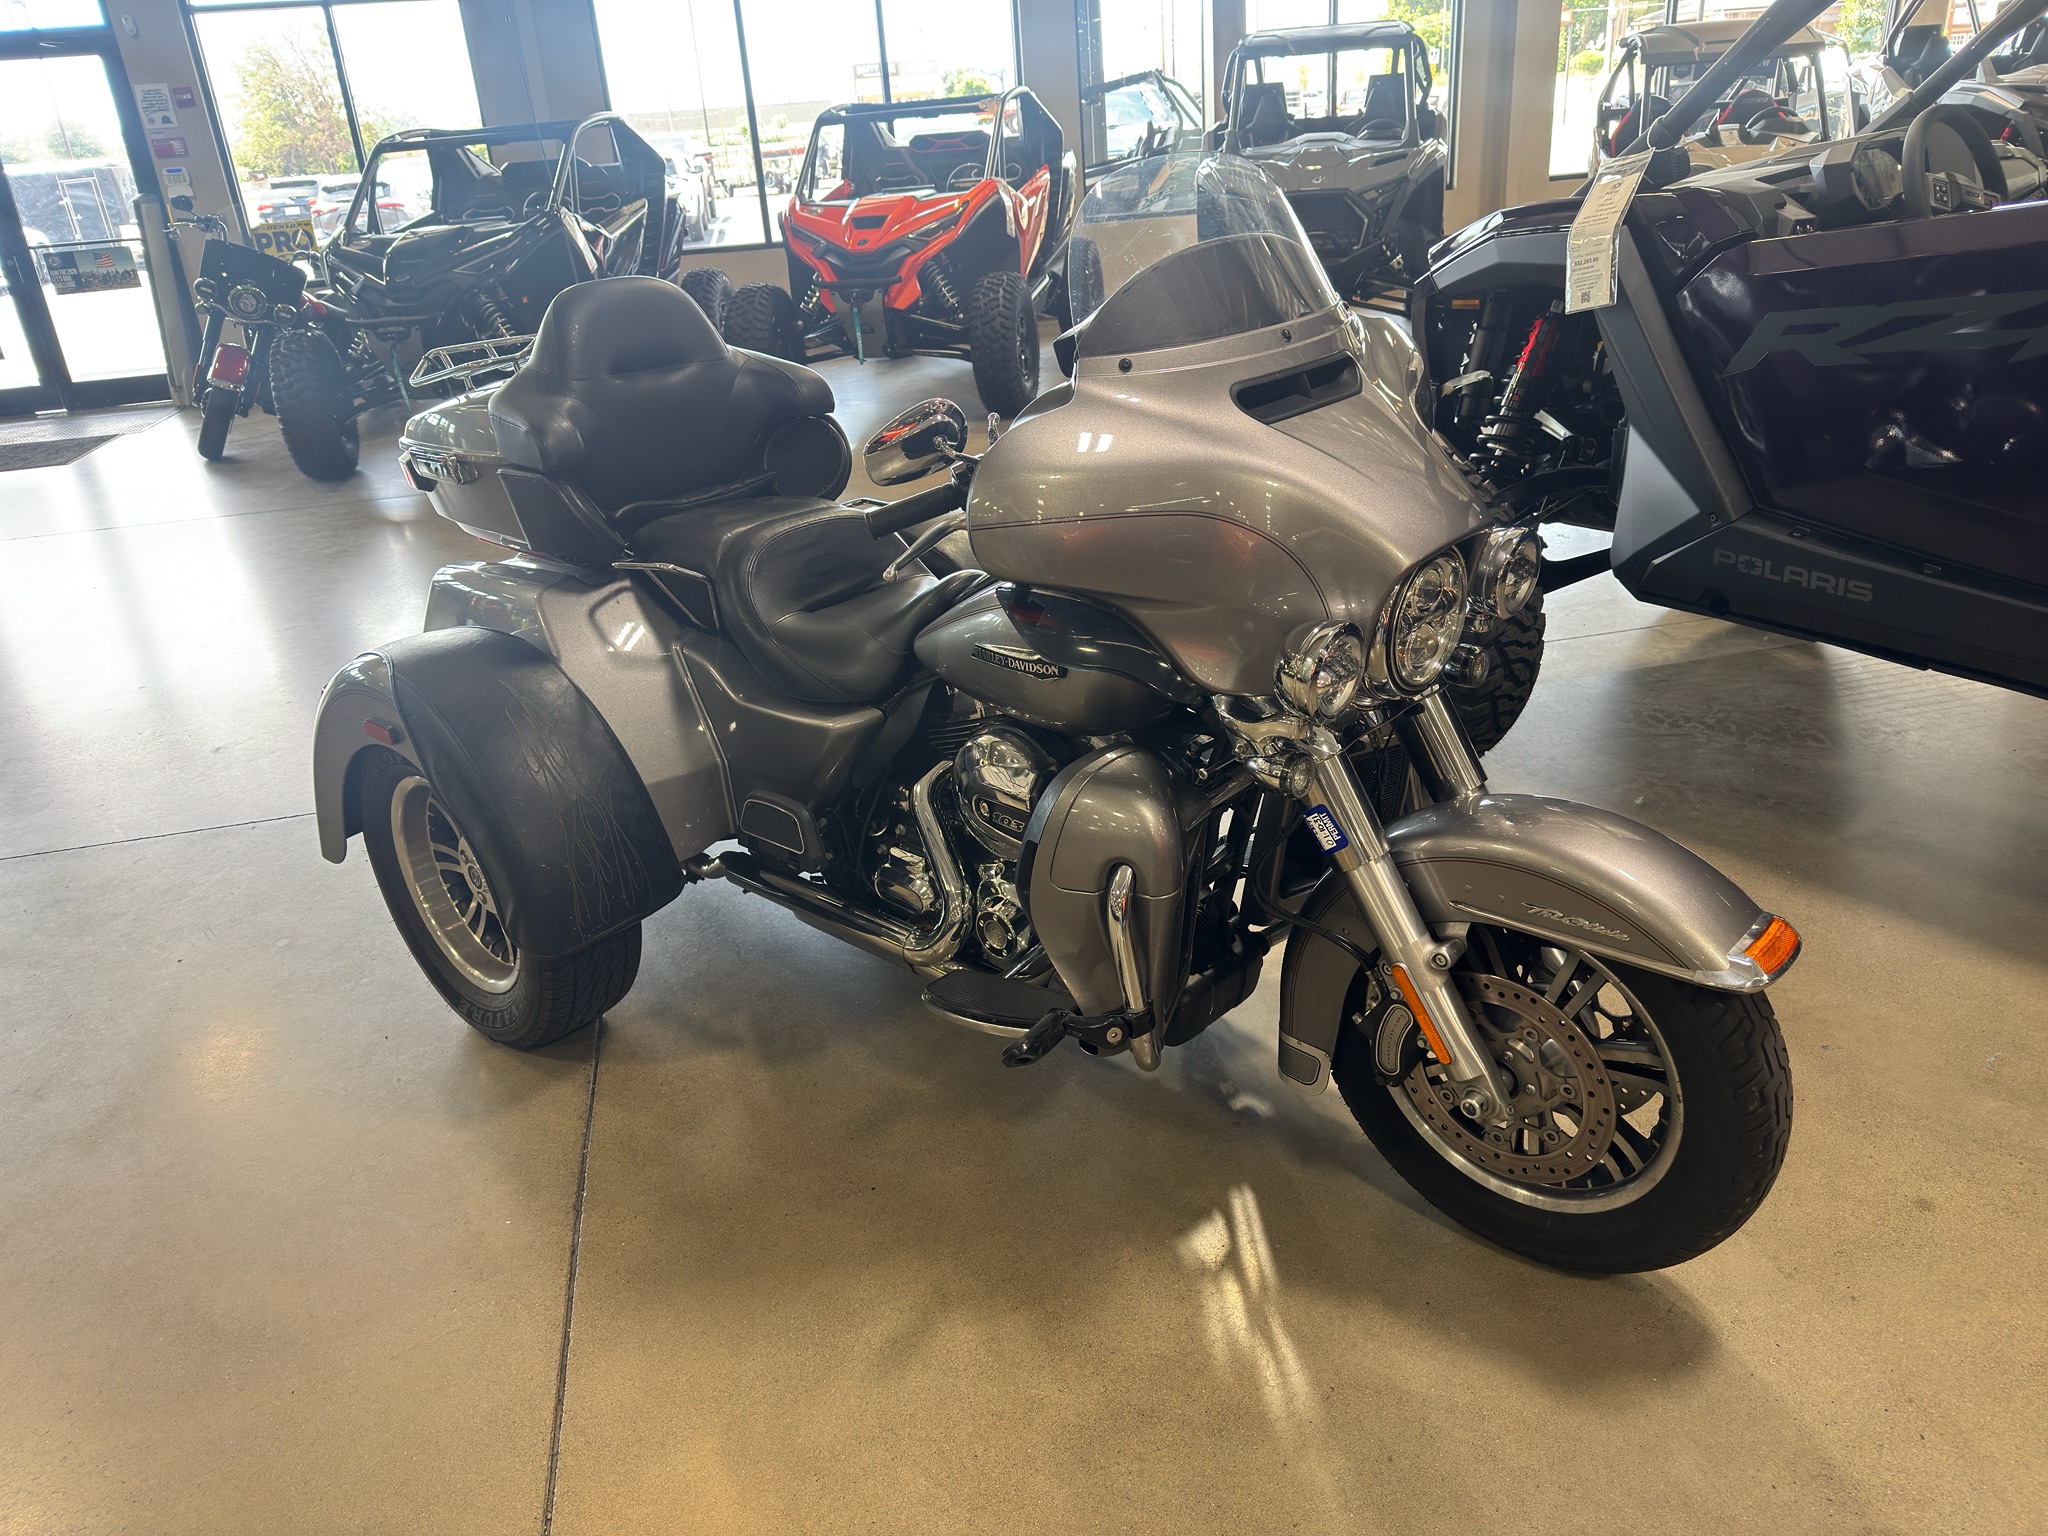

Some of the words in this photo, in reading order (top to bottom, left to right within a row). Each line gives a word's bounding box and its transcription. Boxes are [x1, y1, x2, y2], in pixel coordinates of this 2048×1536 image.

[255, 229, 314, 253] PRO
[267, 223, 302, 231] DUNLOP
[1722, 289, 2048, 377] RZ
[1713, 548, 1873, 602] POLARIS
[975, 648, 1060, 676] HARLEY-DAVIDSON
[993, 811, 1026, 833] 103
[1318, 812, 1342, 841] PERMIT
